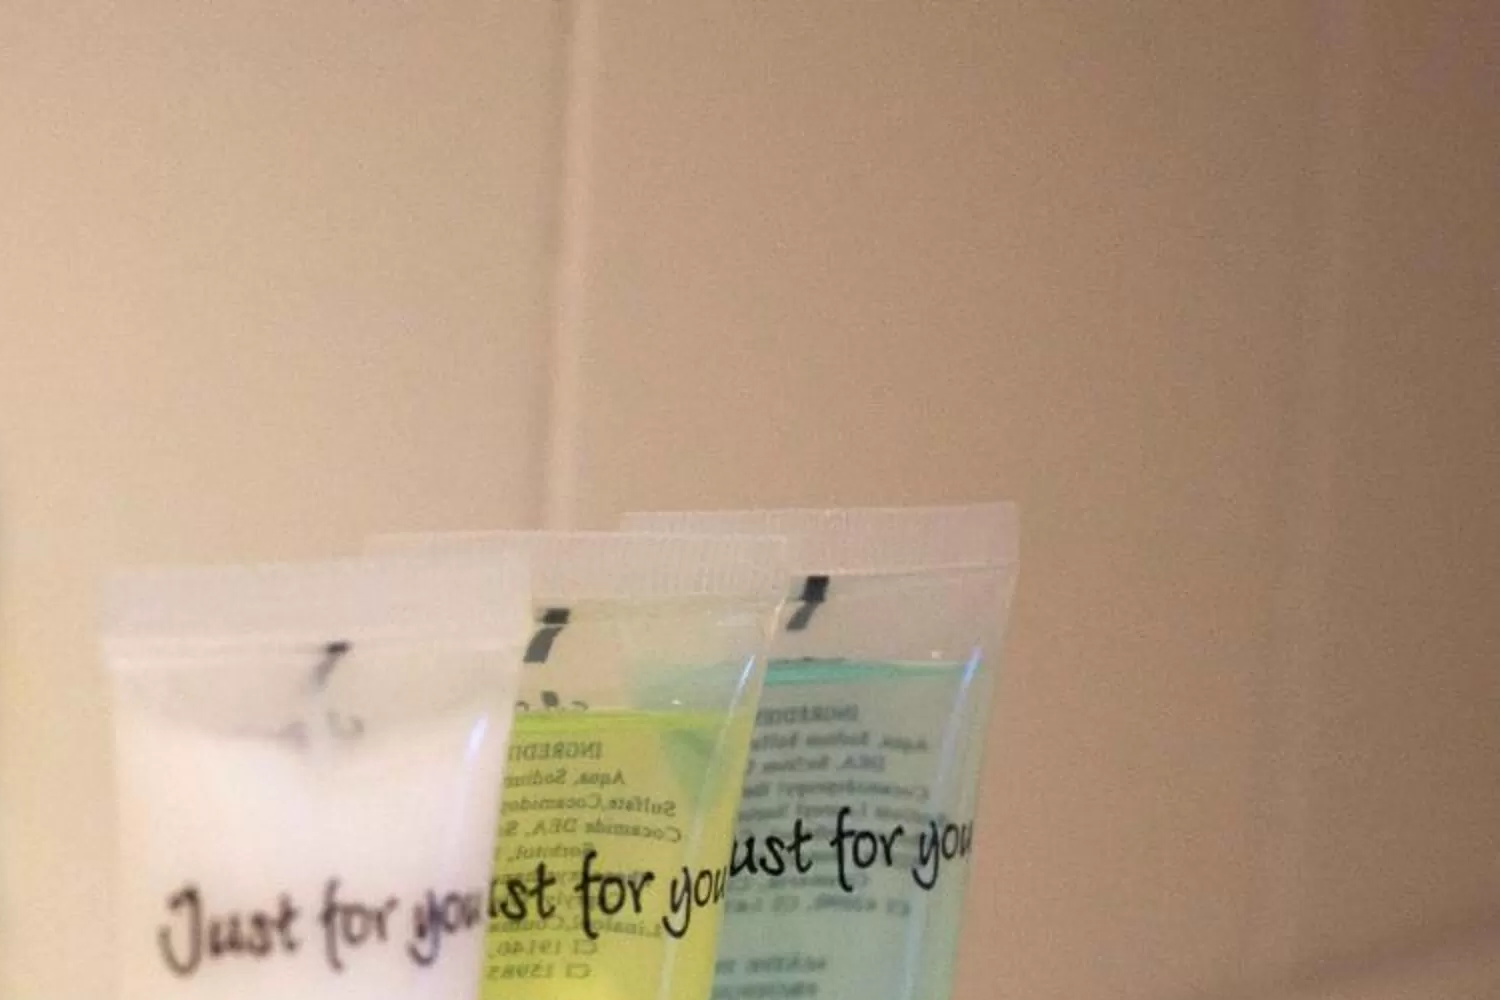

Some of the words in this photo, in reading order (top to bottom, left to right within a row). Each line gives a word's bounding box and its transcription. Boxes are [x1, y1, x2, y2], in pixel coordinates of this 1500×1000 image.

[729, 818, 813, 876] ust
[830, 806, 904, 892] for
[911, 819, 973, 890] you
[158, 878, 301, 977] Just
[318, 875, 397, 973] for
[574, 850, 655, 940] for
[662, 866, 728, 938] you
